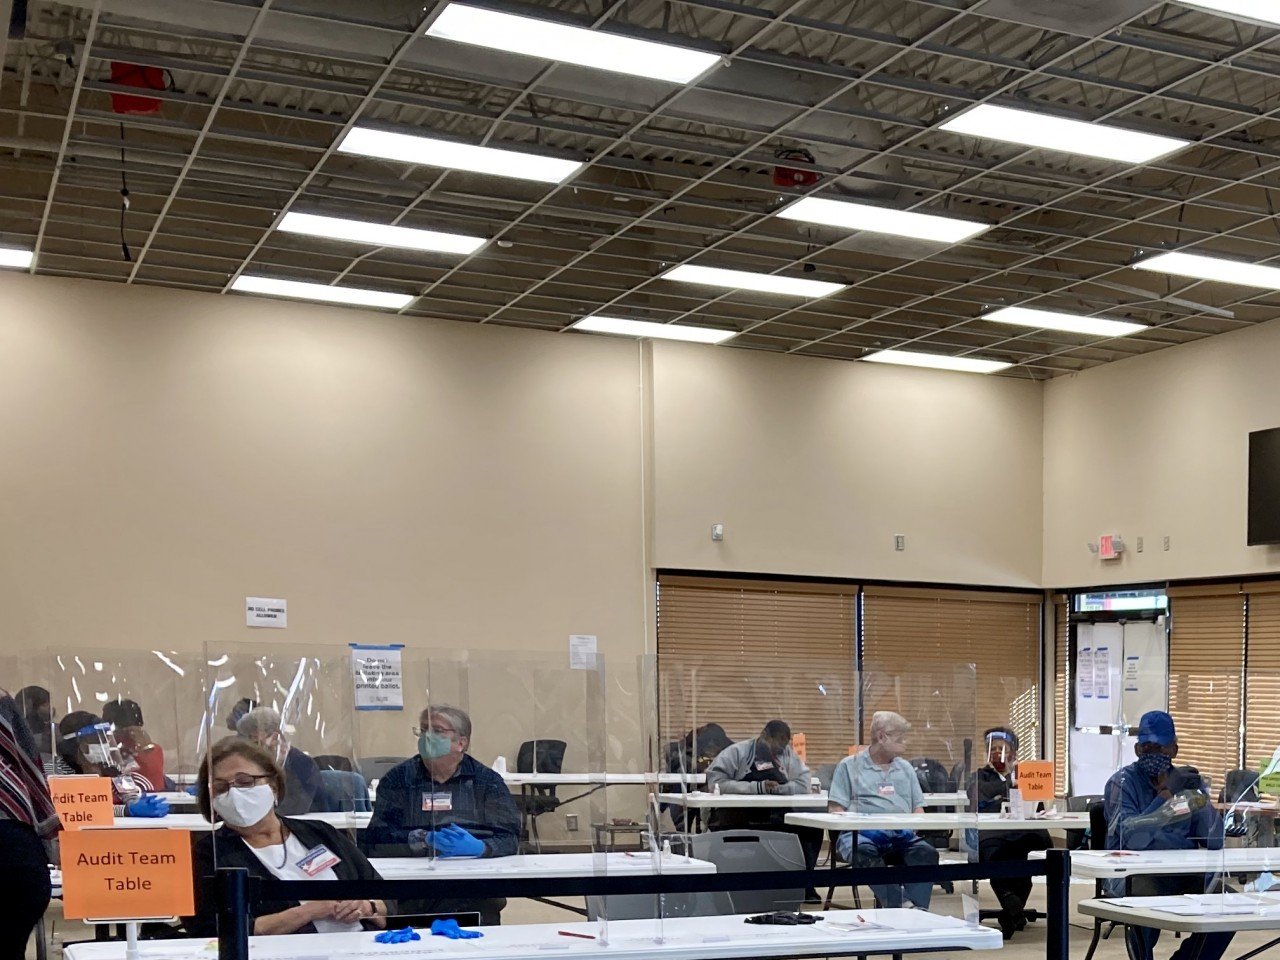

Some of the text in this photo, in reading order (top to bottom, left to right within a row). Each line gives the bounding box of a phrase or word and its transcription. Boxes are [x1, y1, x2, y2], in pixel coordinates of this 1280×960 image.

[78, 792, 108, 803] Team
[62, 812, 93, 822] Table
[77, 852, 176, 865] Audit Team
[104, 877, 152, 890] Table
